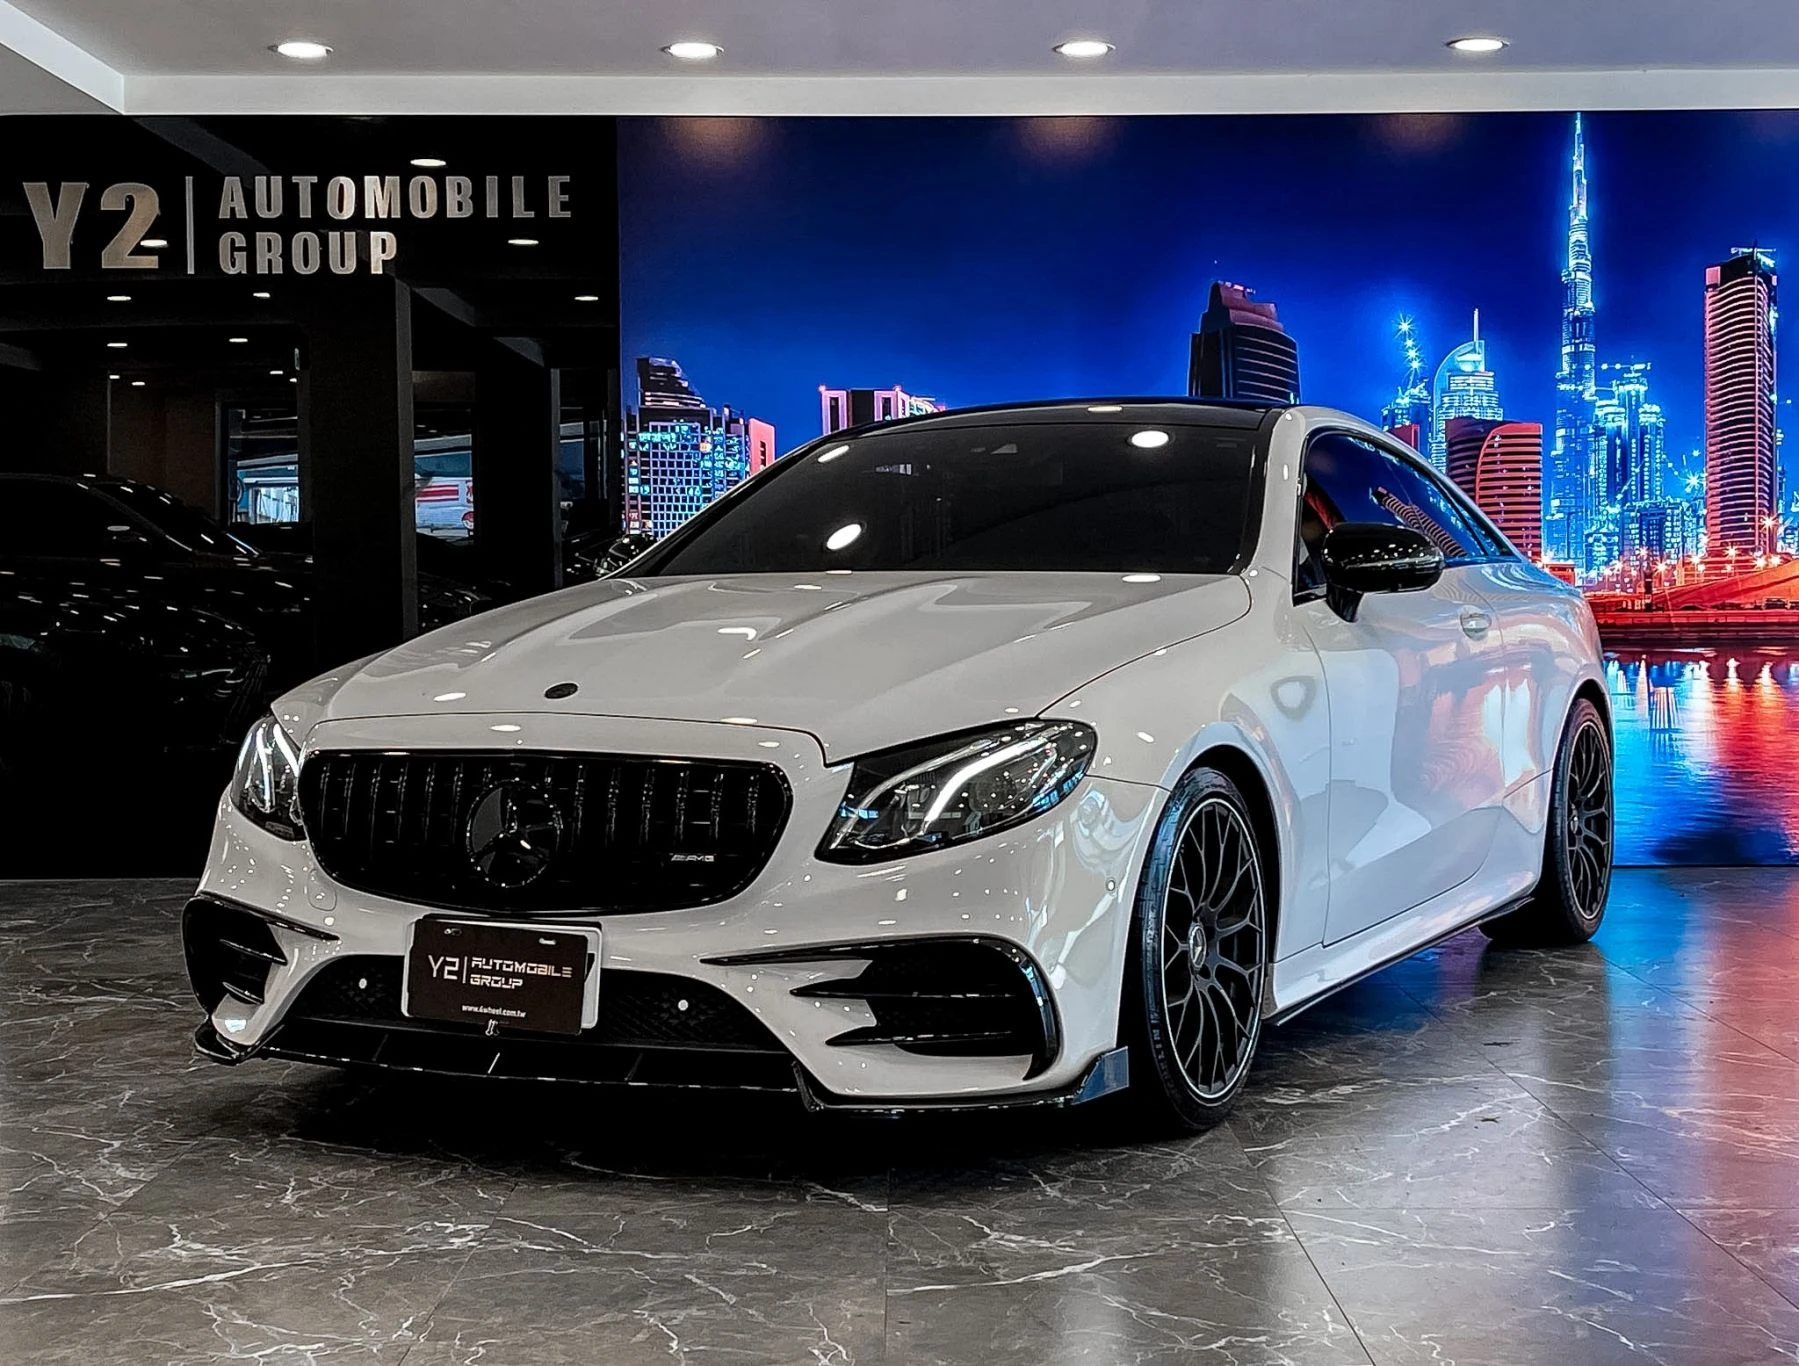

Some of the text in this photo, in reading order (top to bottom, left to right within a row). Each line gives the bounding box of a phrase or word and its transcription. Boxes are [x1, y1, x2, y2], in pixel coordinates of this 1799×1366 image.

[218, 175, 572, 219] AUTOMOBILE
[22, 181, 161, 270] Y2
[218, 231, 398, 274] GROUP
[428, 954, 460, 980] Y2
[470, 974, 523, 989] GROUP
[471, 956, 573, 978] AUTOMOBILE
